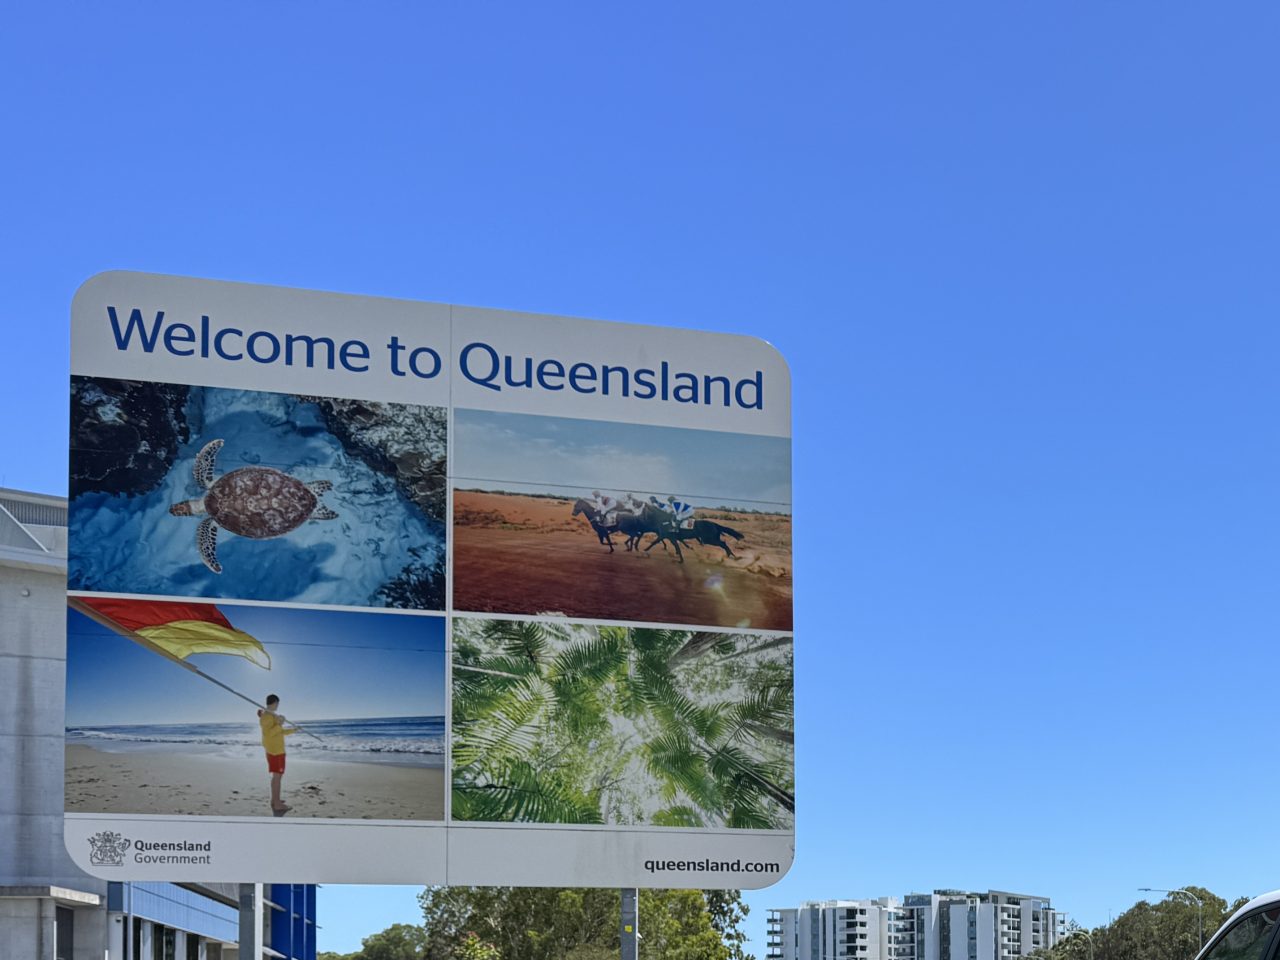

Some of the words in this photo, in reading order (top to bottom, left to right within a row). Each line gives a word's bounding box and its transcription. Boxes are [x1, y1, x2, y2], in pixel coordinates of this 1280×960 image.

[106, 305, 370, 372] Welcome
[387, 335, 442, 379] to
[458, 342, 764, 410] Queensland
[134, 839, 211, 851] Queensland
[134, 852, 211, 865] Government
[644, 858, 780, 873] queensland.com
